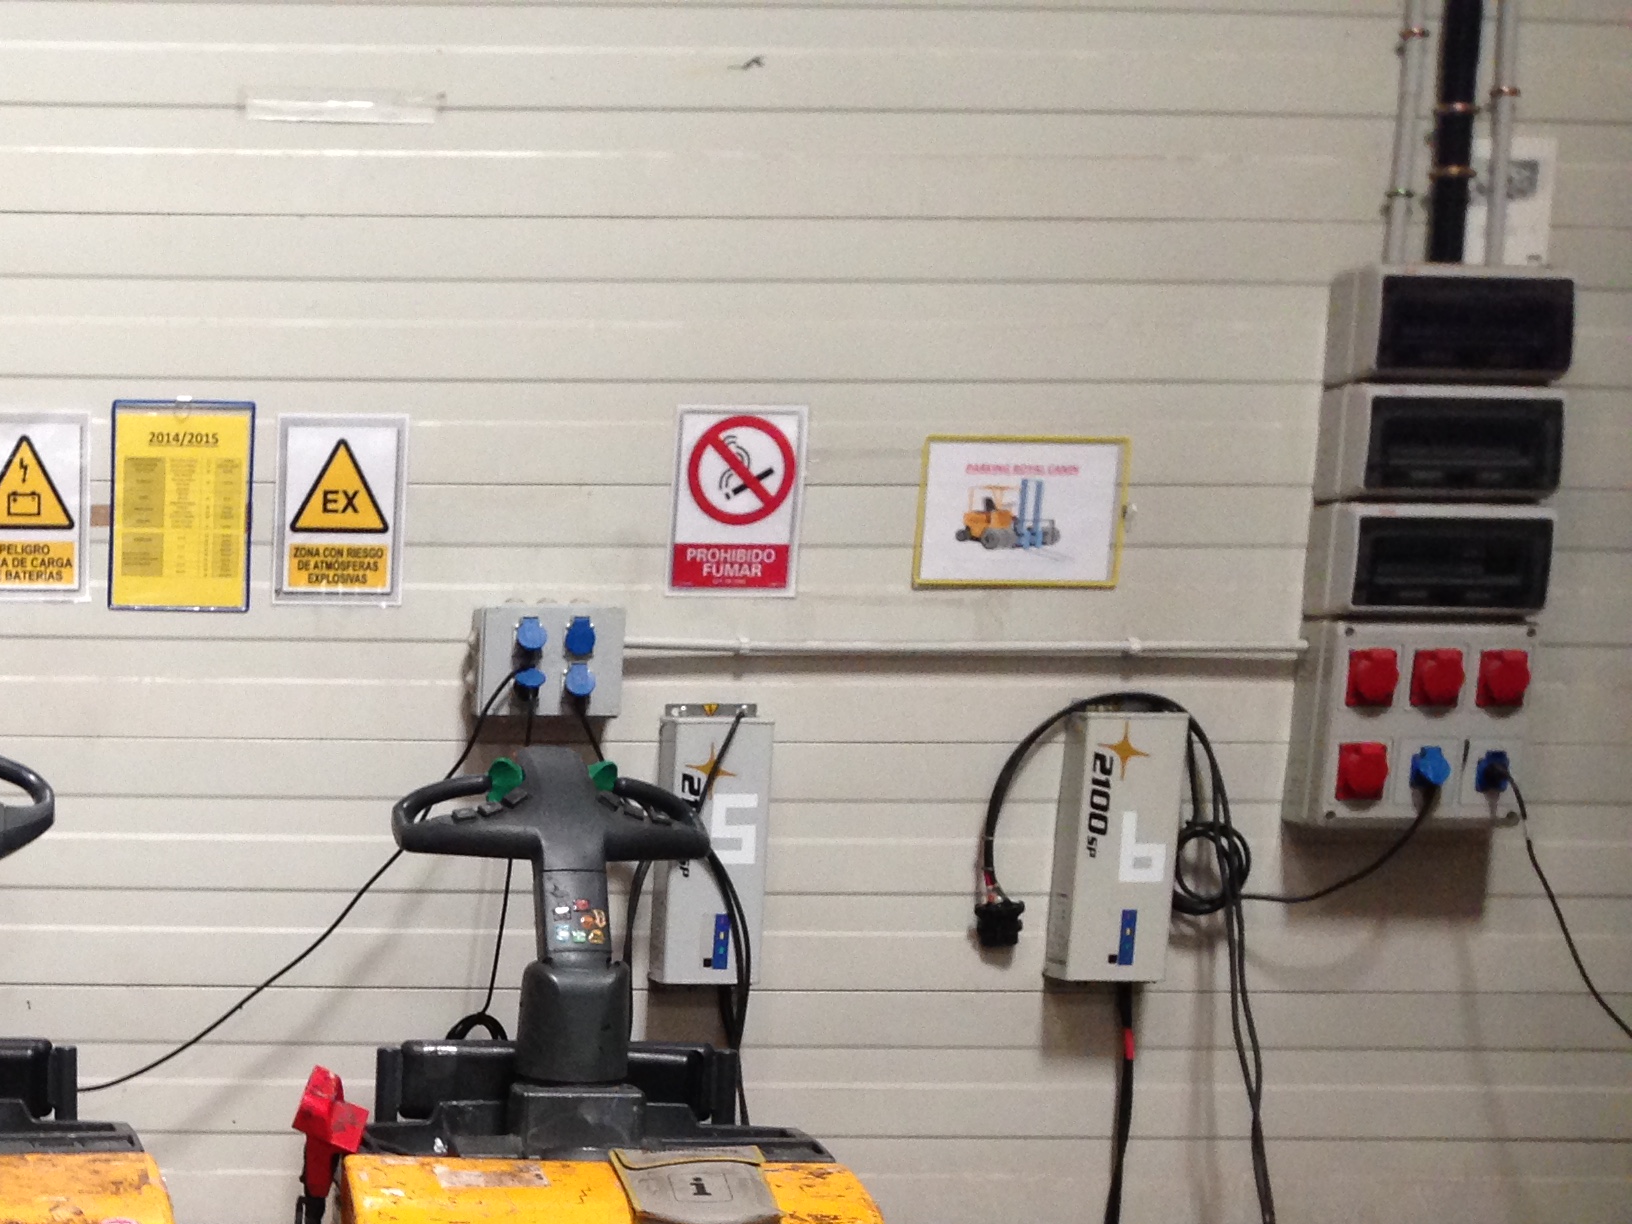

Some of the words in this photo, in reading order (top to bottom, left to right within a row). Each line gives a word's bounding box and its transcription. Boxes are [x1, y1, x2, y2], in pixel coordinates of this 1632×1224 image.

[148, 431, 219, 445] 2014/2015
[322, 489, 360, 514] EX
[0, 543, 50, 555] PELIGRO
[293, 547, 320, 558] ZONA
[322, 547, 344, 558] CON
[346, 547, 384, 559] RIESGO
[686, 547, 776, 563] PROHIBIDO
[11, 557, 28, 568] DE
[30, 556, 73, 568] CARGA
[297, 560, 310, 571] DE
[4, 568, 63, 581] BATERÍAS
[702, 562, 762, 578] FUMAR
[307, 572, 368, 584] EXPLOSIVAS
[1087, 751, 1114, 837] 2100
[711, 793, 758, 865] 5
